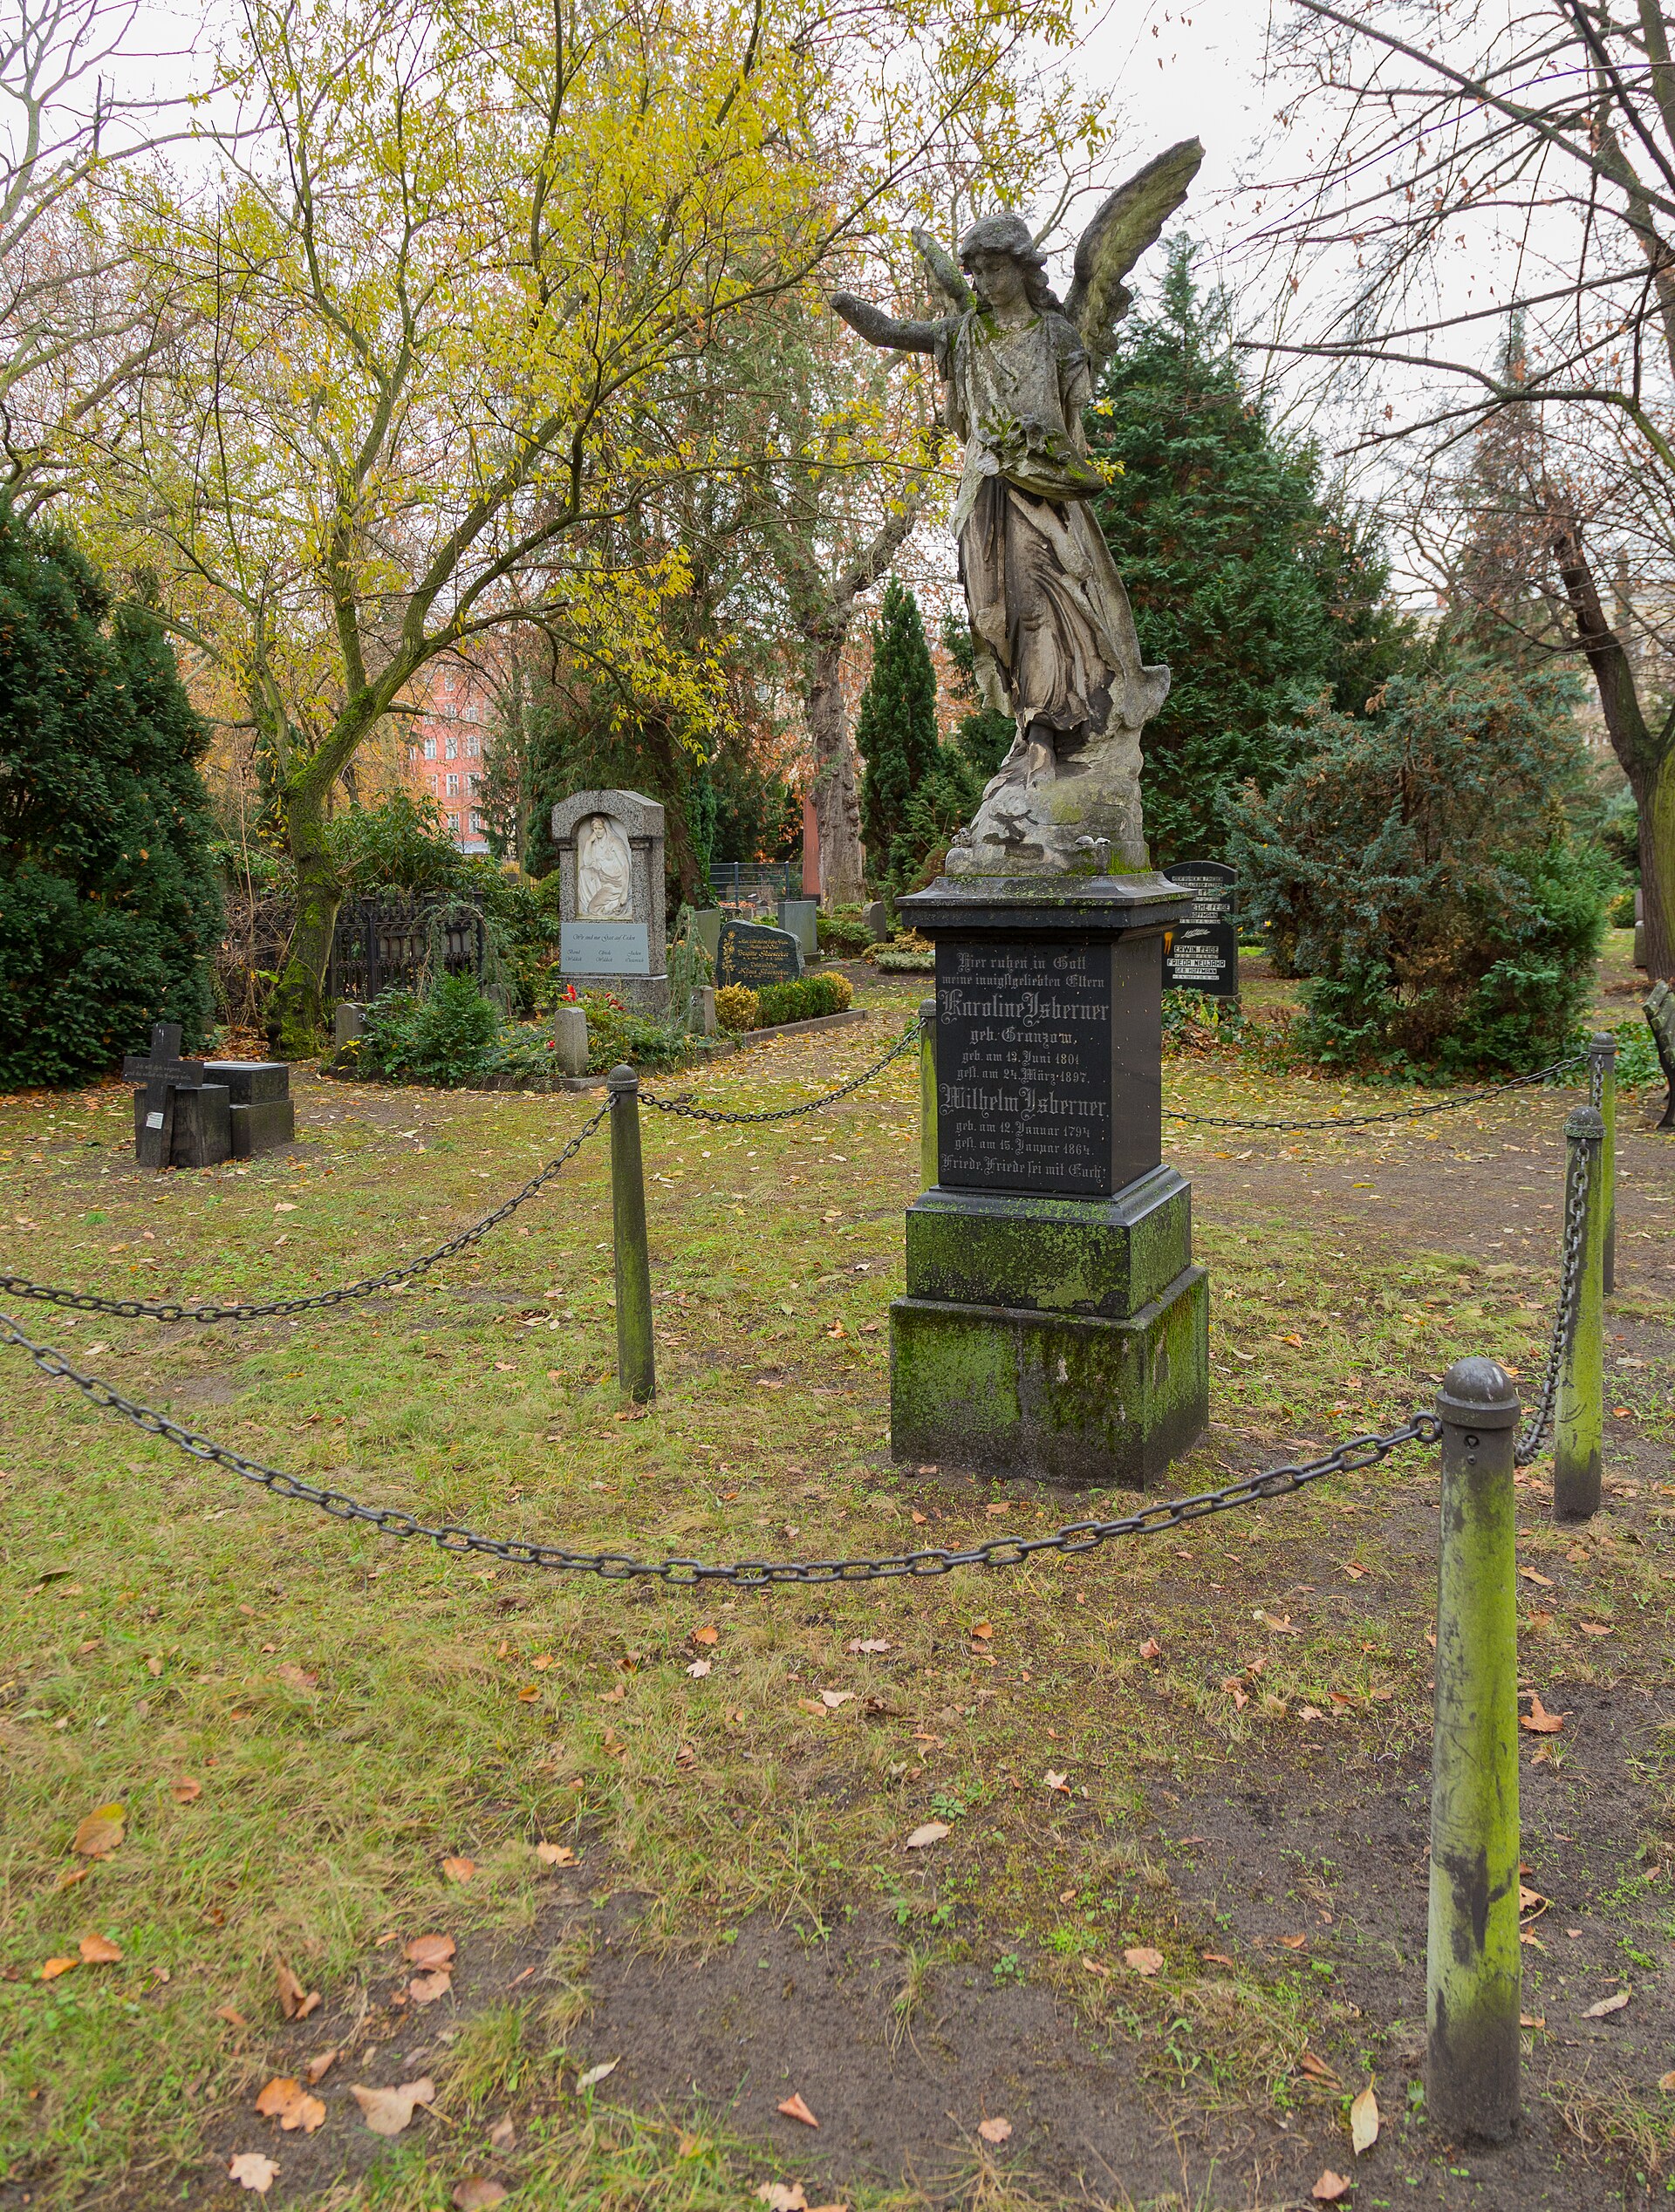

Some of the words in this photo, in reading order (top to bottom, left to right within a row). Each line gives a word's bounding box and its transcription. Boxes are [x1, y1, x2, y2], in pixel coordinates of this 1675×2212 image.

[958, 952, 987, 973] Hier
[991, 955, 1028, 973] ruhen
[1034, 956, 1046, 969] in
[1054, 956, 1087, 970] Gott
[942, 972, 973, 985] meine
[1065, 973, 1105, 987] Eltern
[938, 989, 1025, 1025] Karoline
[969, 1027, 998, 1045] geb.
[961, 1050, 983, 1064] geb.
[986, 1053, 1003, 1062] am
[982, 1070, 999, 1080] am
[939, 1083, 1020, 1119] Wilhelm
[955, 1121, 977, 1134] geb.
[980, 1124, 996, 1133] am
[1015, 1122, 1060, 1137] Januar
[980, 1141, 996, 1150] am
[1015, 1138, 1060, 1156] Januar
[983, 1156, 1026, 1176] Friede
[1046, 1163, 1065, 1176] mit
